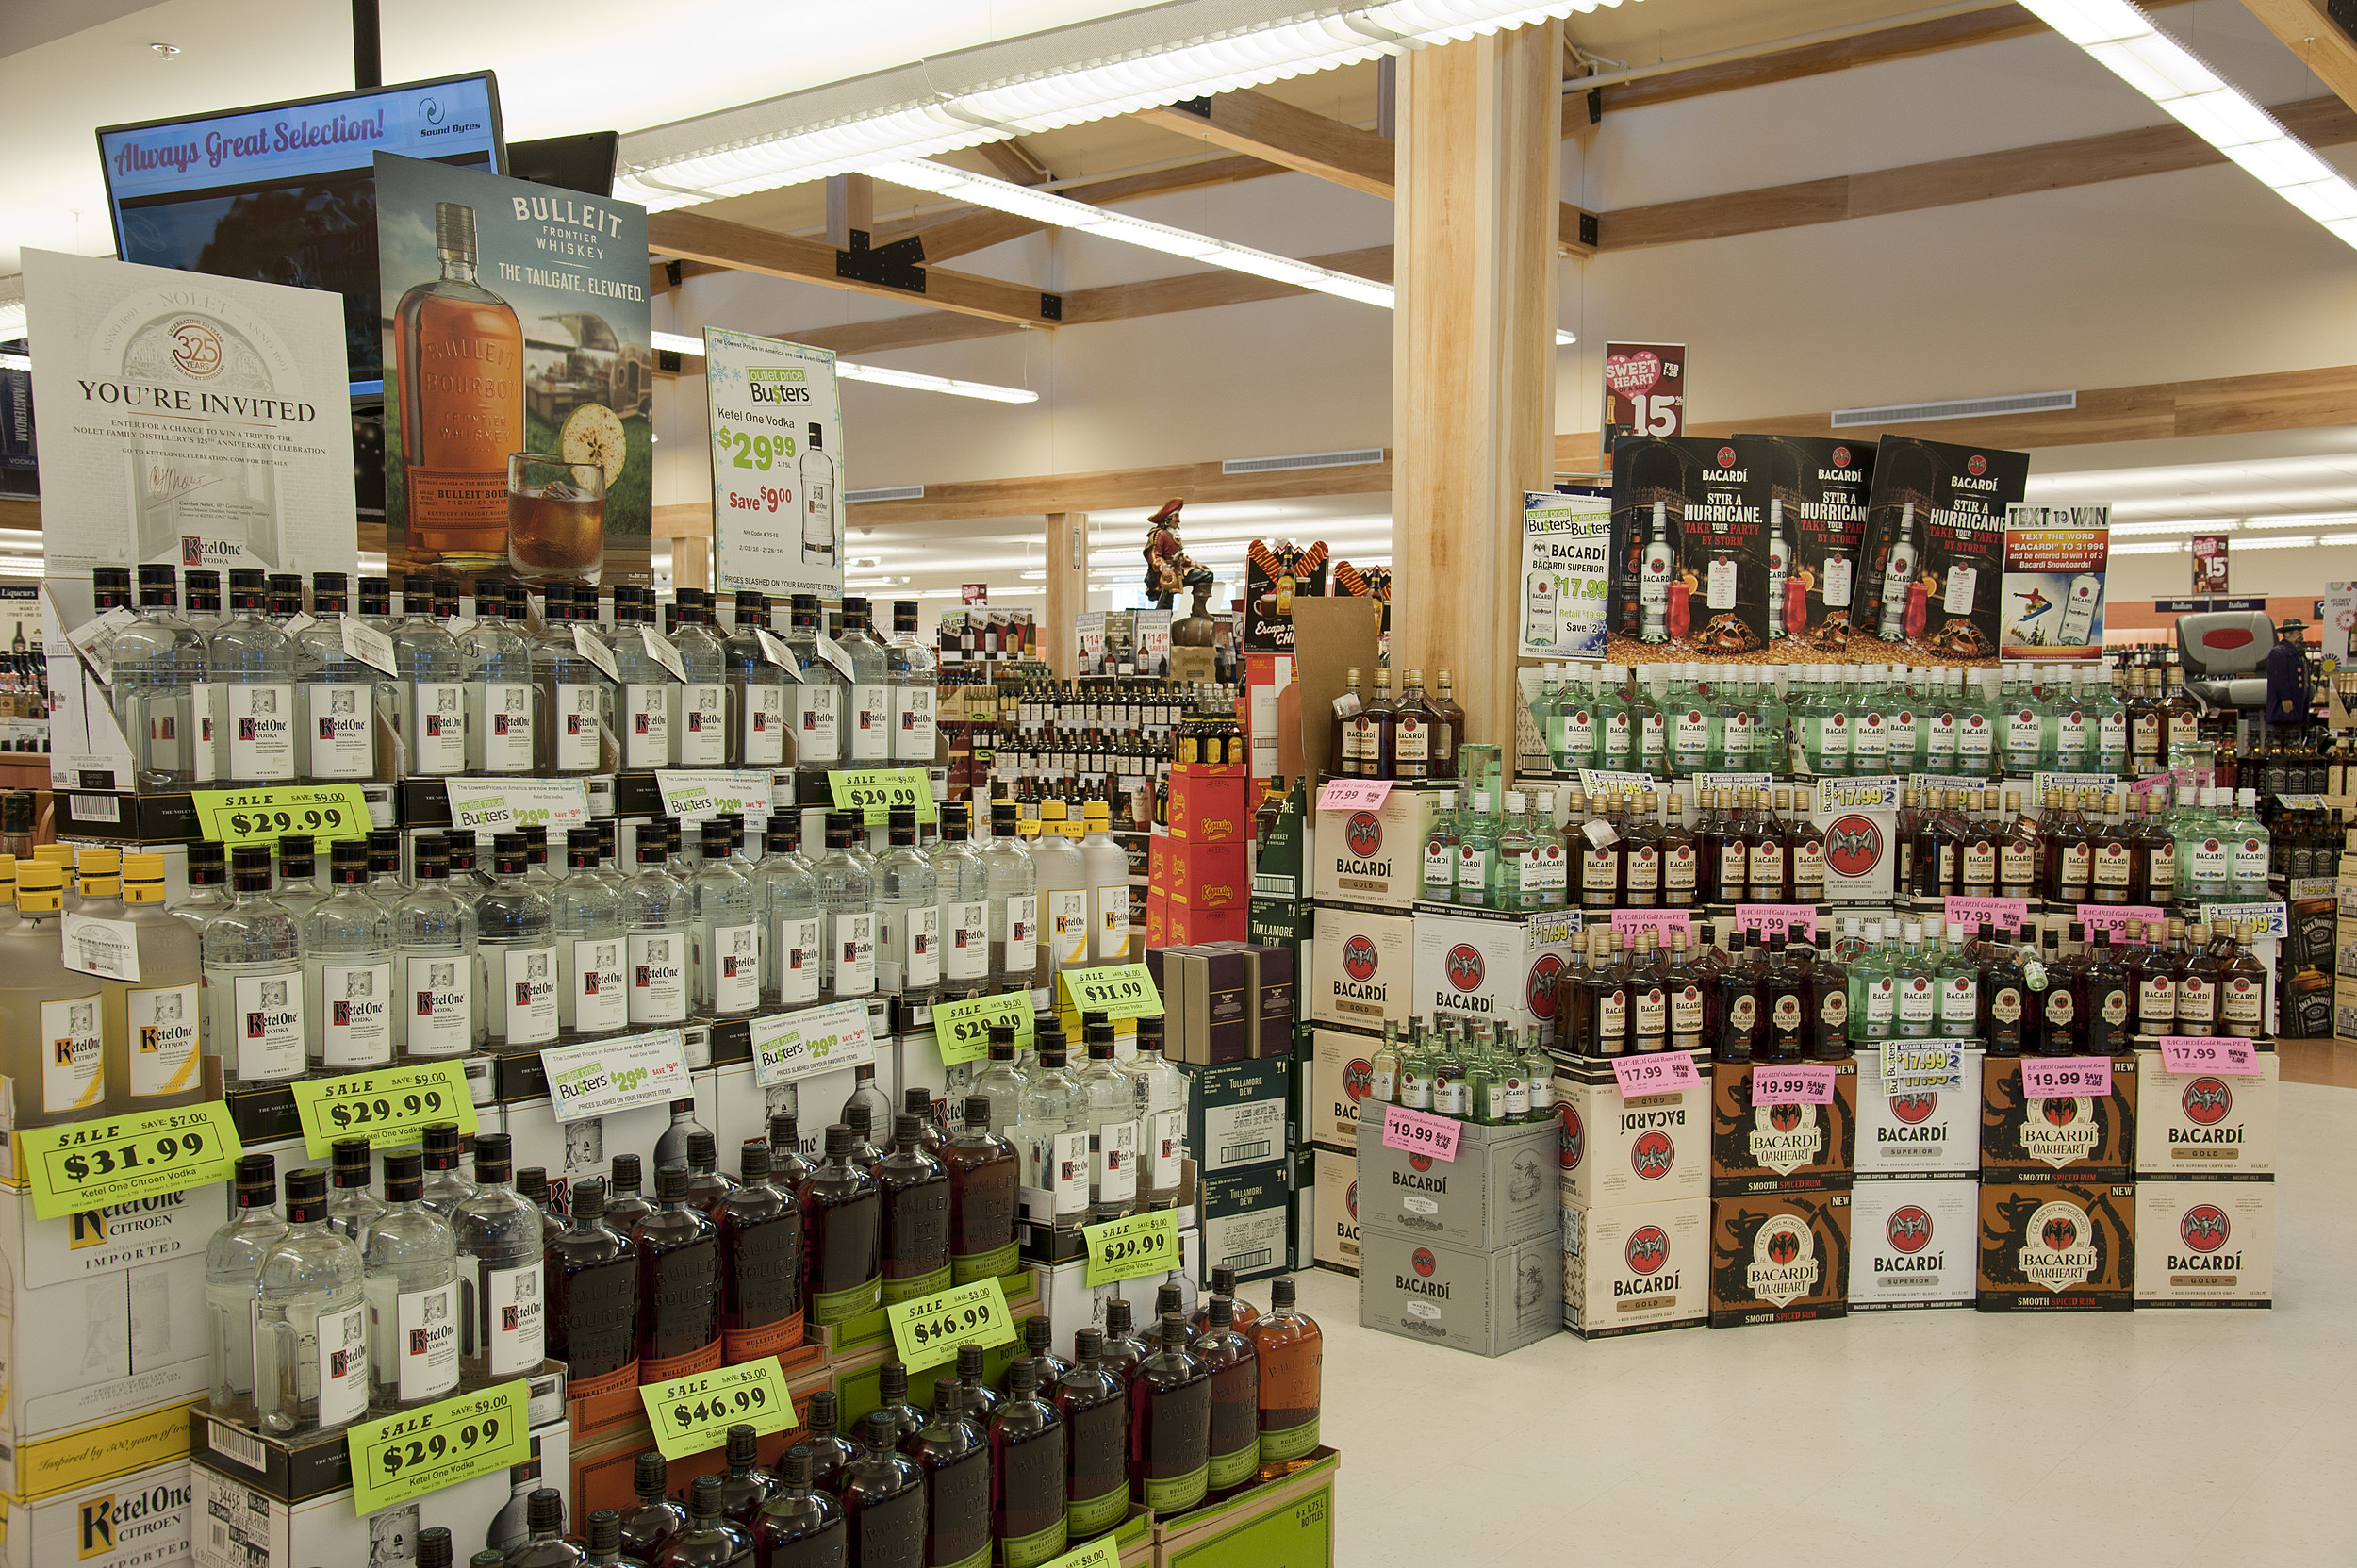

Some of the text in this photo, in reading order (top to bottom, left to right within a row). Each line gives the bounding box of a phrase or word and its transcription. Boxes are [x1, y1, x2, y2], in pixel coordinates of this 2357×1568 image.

[420, 122, 481, 138] Sound Bytes
[114, 109, 384, 176] Always Great Selection!
[512, 197, 623, 239] BULLEIT
[543, 225, 597, 244] FRONTIER
[536, 237, 604, 260] WHISKEY
[499, 262, 645, 302] THE TAILGATE. ELEVATED.
[158, 291, 232, 314] NOLET
[173, 335, 218, 362] 325
[185, 361, 209, 370] YEARS
[1607, 360, 1657, 378] SWEET
[750, 370, 803, 383] outlet price
[1614, 373, 1654, 388] HEART
[77, 380, 316, 421] YOU'RE INVITED
[13, 387, 28, 442] AMSTERDAM
[718, 408, 795, 429] Ketel One Vodka
[1631, 395, 1676, 437] 15
[111, 420, 140, 428] ENTER
[170, 425, 204, 434] CHANCE
[74, 427, 105, 436] NOLET
[107, 429, 136, 438] FAMILY
[140, 432, 194, 443] DISTILLERY'S
[217, 439, 272, 450] ANNIVERSARY
[273, 444, 326, 454] CELEBRATION
[1703, 468, 1747, 482] BACARDÍ
[1951, 476, 1998, 491] BACARDÍ
[730, 492, 760, 511] Save
[1707, 494, 1742, 505] STIR A
[1685, 504, 1762, 523] HURRICANE.
[2009, 507, 2108, 526] TEXT TO WIN
[1685, 522, 1709, 534] TAKE
[1730, 524, 1759, 536] PARTY
[1702, 536, 1744, 546] BY STORM.
[182, 536, 240, 566] Ketel One
[1552, 543, 1606, 560] BACARDÍ
[1533, 561, 1604, 573] BACARDI SUPERIOR
[2, 589, 35, 598] Liqueurs
[1554, 575, 1608, 599] $17.99
[1559, 609, 1606, 619] Retail $19.99
[2172, 602, 2192, 610] Italian
[2228, 601, 2249, 609] Italian
[1255, 620, 1286, 637] Escape
[1567, 623, 1597, 634] Save $2
[239, 717, 286, 740] Ketel One
[1398, 731, 1425, 740] BACARDÍ
[1680, 724, 1706, 733] BACARDÍ
[1834, 787, 1883, 806] $17.99
[231, 809, 341, 834] $29.99
[1337, 857, 1392, 877] BACARDÍ
[1951, 908, 2020, 922] $17.99 SAVE
[1085, 982, 1141, 1003] $31.99
[1836, 1065, 1854, 1074] NEW
[1229, 1077, 1262, 1089] TULLAMORE
[1239, 1087, 1253, 1097] DEW
[58, 1113, 207, 1147] SALE SAVE: $7.00
[1389, 1120, 1451, 1144] $19.99 SAVE
[1877, 1122, 1948, 1142] BACARDÍ
[2168, 1123, 2244, 1143] BACARDÍ
[1754, 1131, 1819, 1149] BACARDÍ
[64, 1132, 203, 1183] $31.99
[1761, 1148, 1810, 1162] OAKHEART
[81, 1167, 197, 1198] Ketel One Citroen Vodka
[1393, 1171, 1447, 1194] BACARDÍ
[1749, 1179, 1821, 1191] SMOOTH SPICED RUM
[1409, 1197, 1433, 1206] MAESTRO
[110, 1213, 172, 1237] CITROEN
[86, 1240, 181, 1269] IMPORTED
[909, 1299, 943, 1317] SALE
[970, 1288, 990, 1300] $3.00
[914, 1305, 989, 1345] $46.99
[38, 1425, 172, 1472] Inspired by 300 years of
[383, 1418, 500, 1477] $29.99
[219, 1486, 240, 1511] 34458
[1302, 1510, 1323, 1527] BOTTLES
